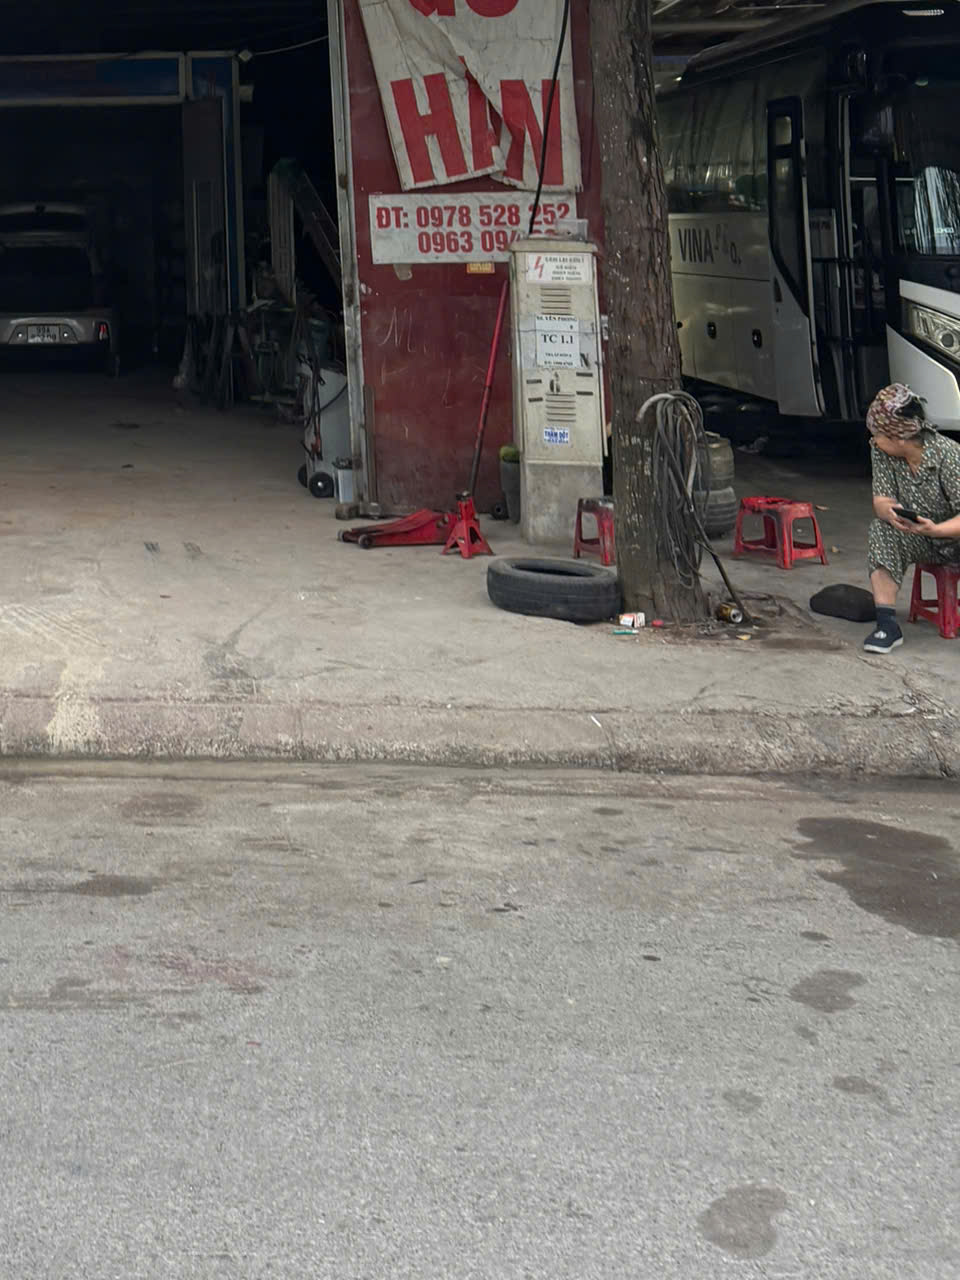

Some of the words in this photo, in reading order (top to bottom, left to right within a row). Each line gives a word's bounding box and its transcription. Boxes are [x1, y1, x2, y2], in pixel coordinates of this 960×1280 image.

[376, 206, 409, 229] ĐT:
[415, 204, 472, 228] 0978
[479, 203, 520, 227] 528
[418, 231, 473, 254] 0963
[541, 334, 558, 344] TC
